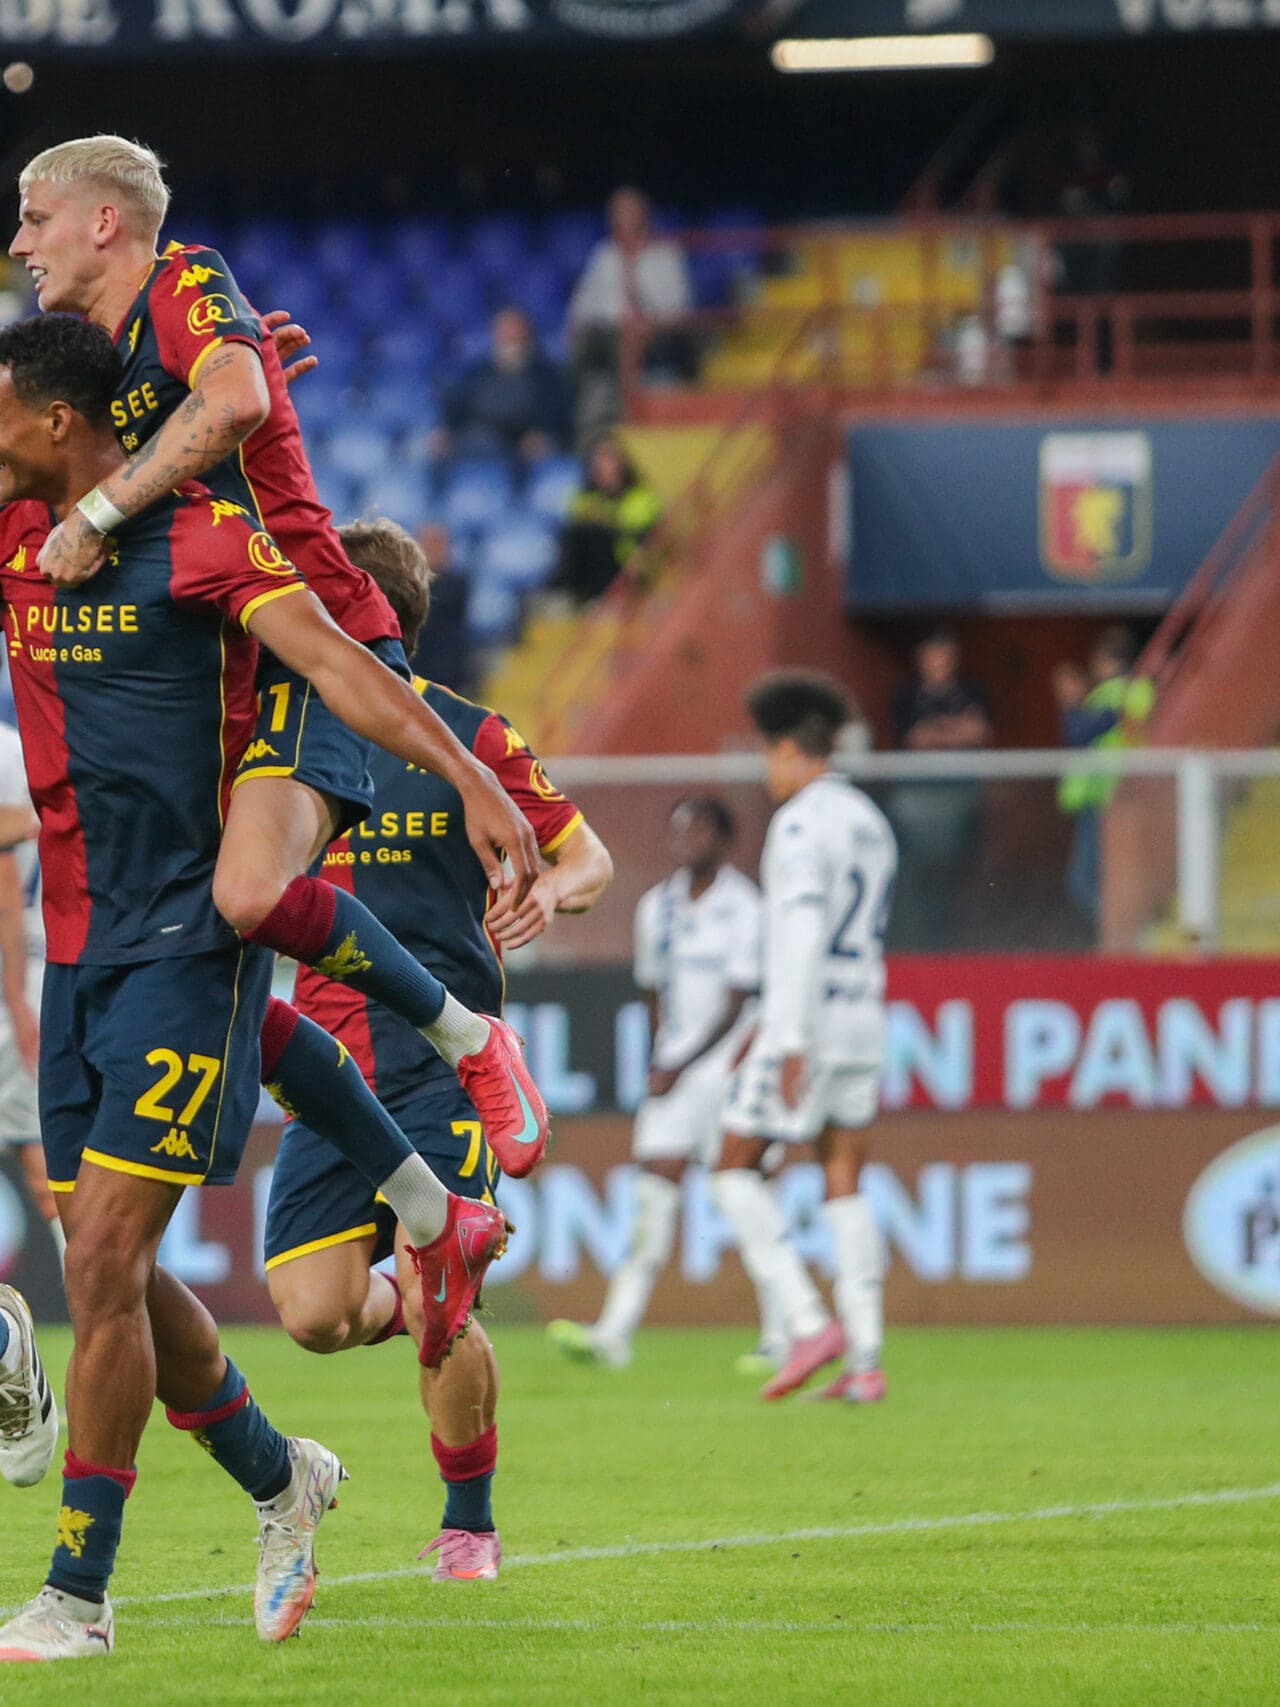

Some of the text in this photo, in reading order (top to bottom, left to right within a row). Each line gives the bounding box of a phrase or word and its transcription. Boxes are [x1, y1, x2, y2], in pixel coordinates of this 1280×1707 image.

[27, 604, 139, 633] PULSEE
[29, 643, 102, 663] Luce e Gas
[360, 851, 372, 865] e
[376, 847, 413, 863] Gas
[133, 1047, 221, 1127] 27
